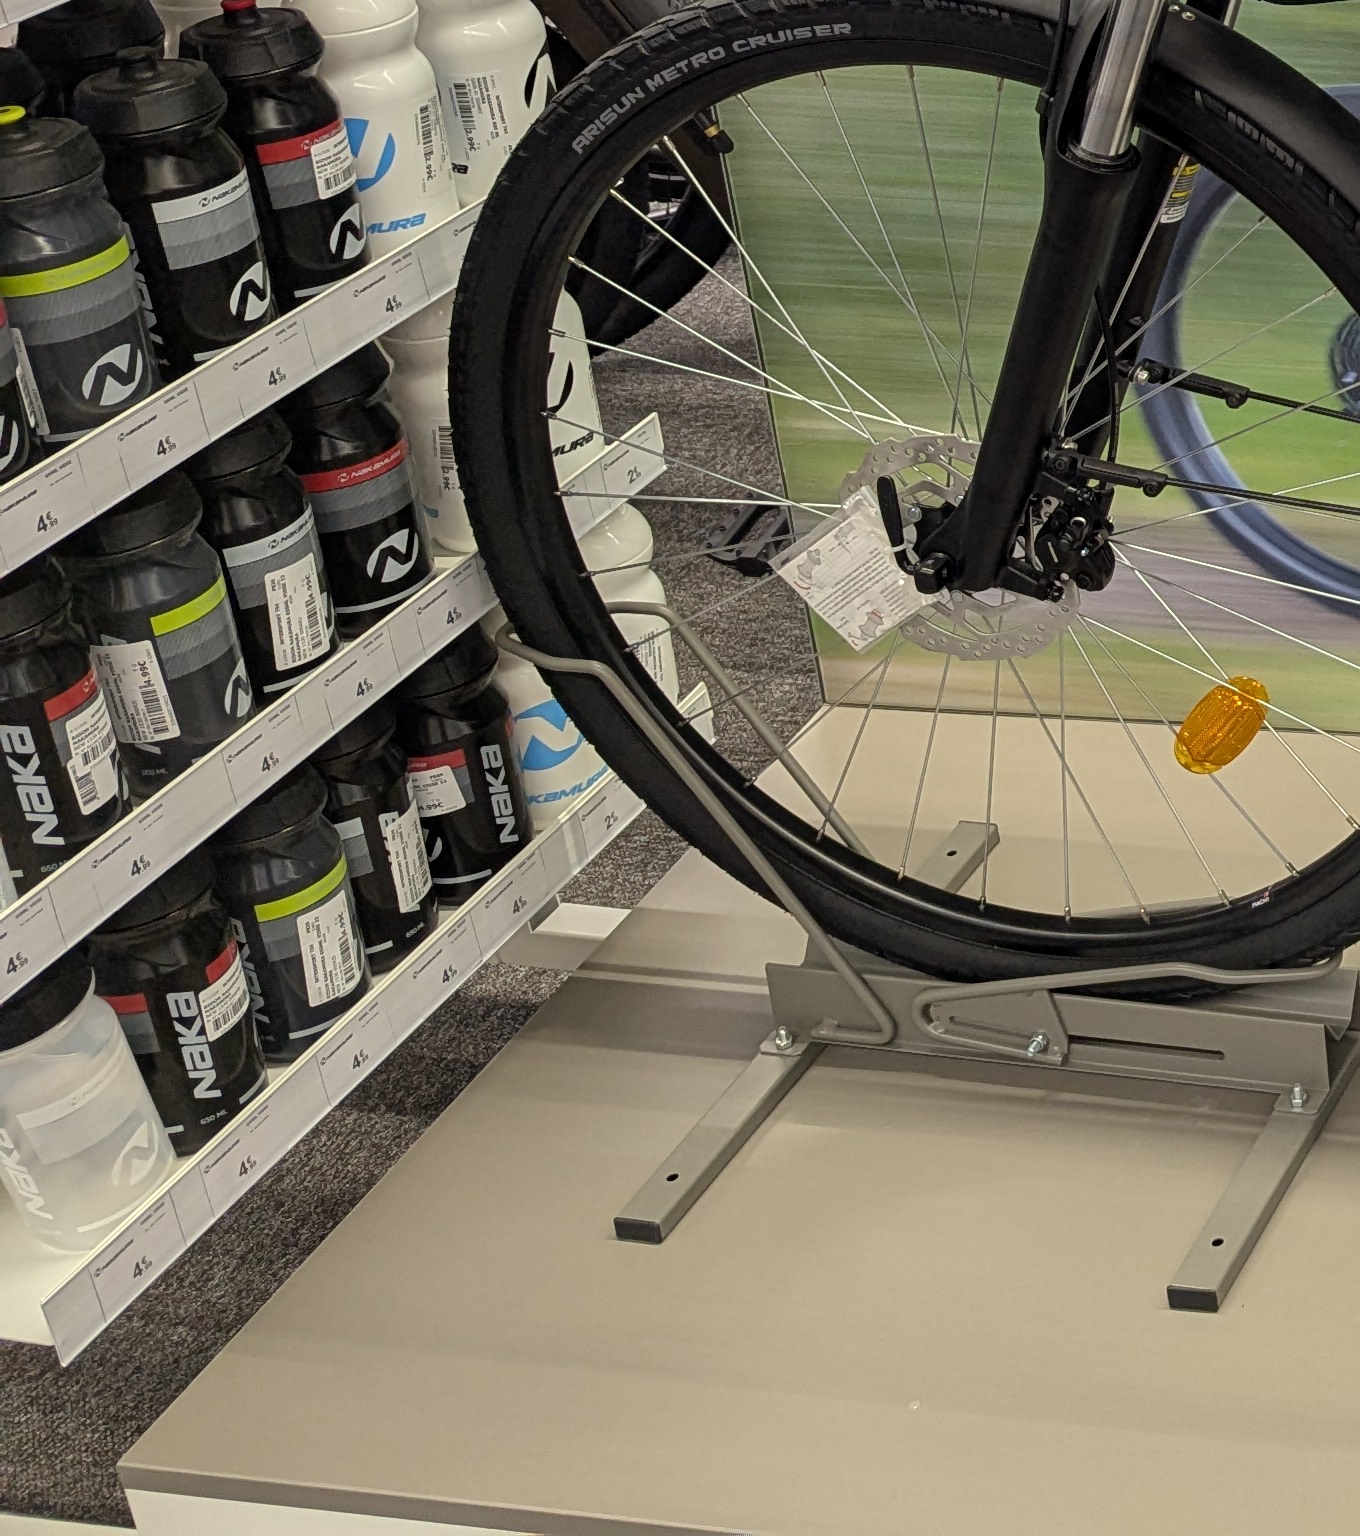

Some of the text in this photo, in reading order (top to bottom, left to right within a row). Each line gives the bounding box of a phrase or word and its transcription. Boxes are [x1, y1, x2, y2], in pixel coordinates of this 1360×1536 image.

[571, 22, 852, 155] ARISUN METRO CRUISER
[3, 725, 65, 846] NAKA
[480, 744, 519, 843] NAKA
[166, 991, 222, 1098] NAKA
